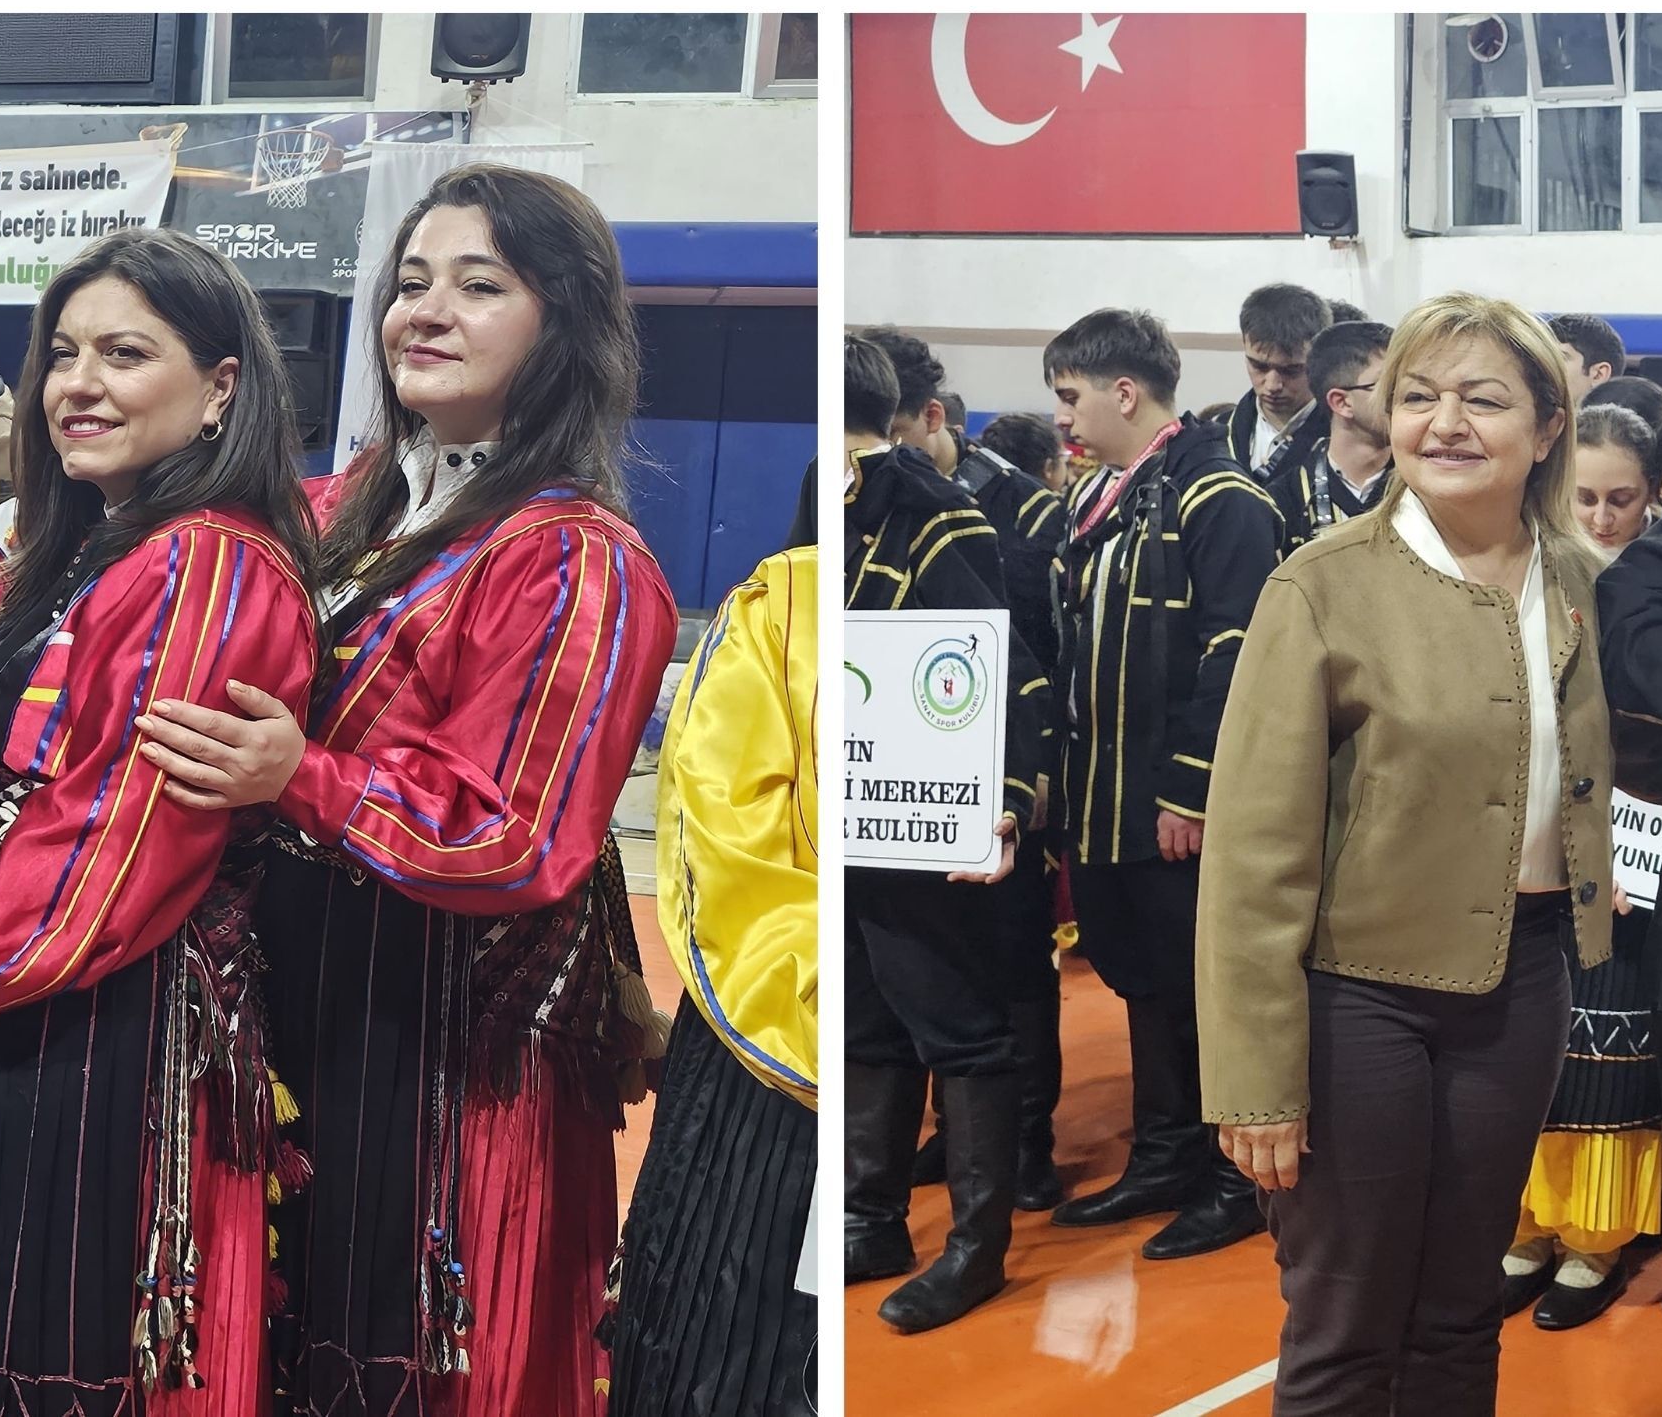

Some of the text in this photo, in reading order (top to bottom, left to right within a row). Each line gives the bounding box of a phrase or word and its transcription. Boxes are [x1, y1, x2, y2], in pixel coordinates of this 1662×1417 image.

[19, 162, 128, 191] sahnede.
[61, 210, 76, 237] iz
[195, 223, 276, 241] SPOR
[860, 775, 981, 806] MERKEZİ
[856, 811, 959, 845] KULÜBÜ
[1612, 803, 1646, 833] VİN
